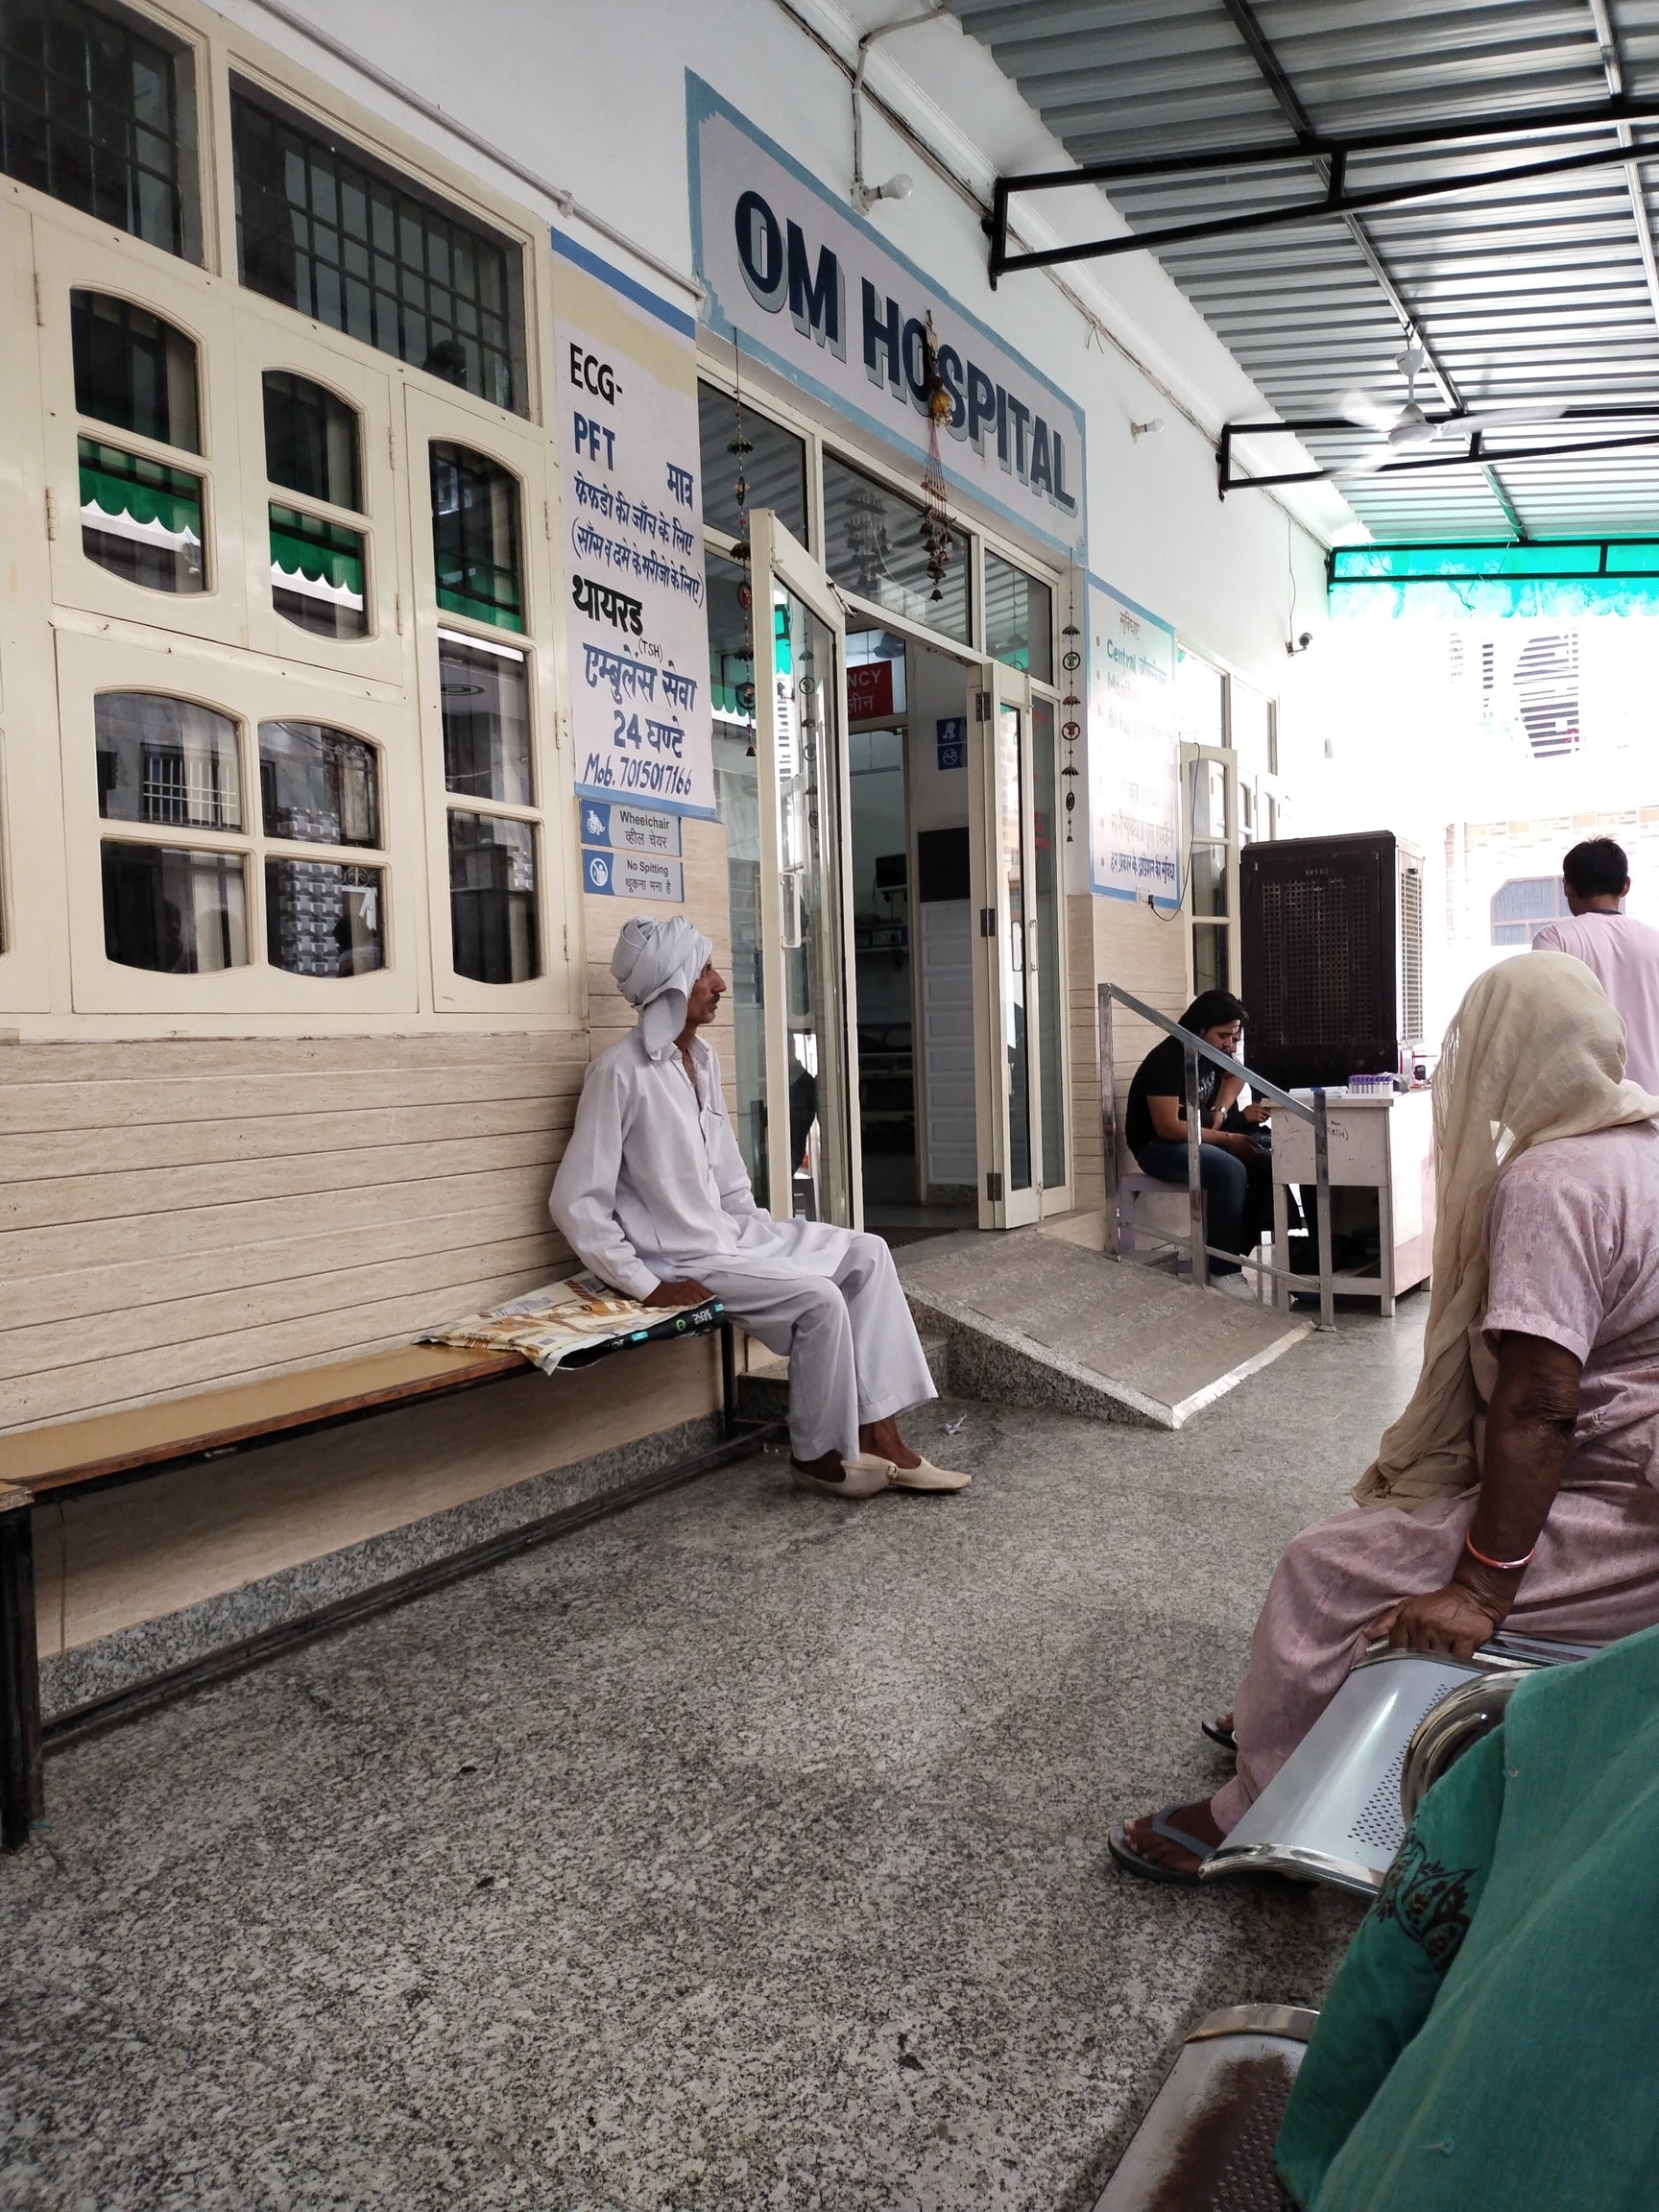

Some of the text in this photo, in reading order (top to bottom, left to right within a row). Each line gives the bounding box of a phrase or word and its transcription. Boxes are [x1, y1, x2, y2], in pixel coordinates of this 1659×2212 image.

[734, 191, 1078, 518] OM HOSPITAL
[569, 341, 623, 406] ECG-
[573, 410, 615, 471] PFT
[615, 491, 631, 527] की
[659, 510, 671, 545] के
[672, 517, 694, 556] लिए
[633, 542, 641, 577] के
[637, 637, 663, 663] (TSH)
[1106, 638, 1137, 674] Central
[661, 660, 698, 712] सेवा
[847, 669, 881, 688] NCY
[848, 692, 875, 713] लीन
[613, 709, 685, 758] 24 घण्टे
[583, 752, 692, 796] Mob. 7015017166
[619, 810, 670, 830] Wheelchair
[625, 828, 667, 849] व्हील चेयर
[627, 859, 669, 878] No Spitting
[625, 878, 672, 895] थूकना मना है
